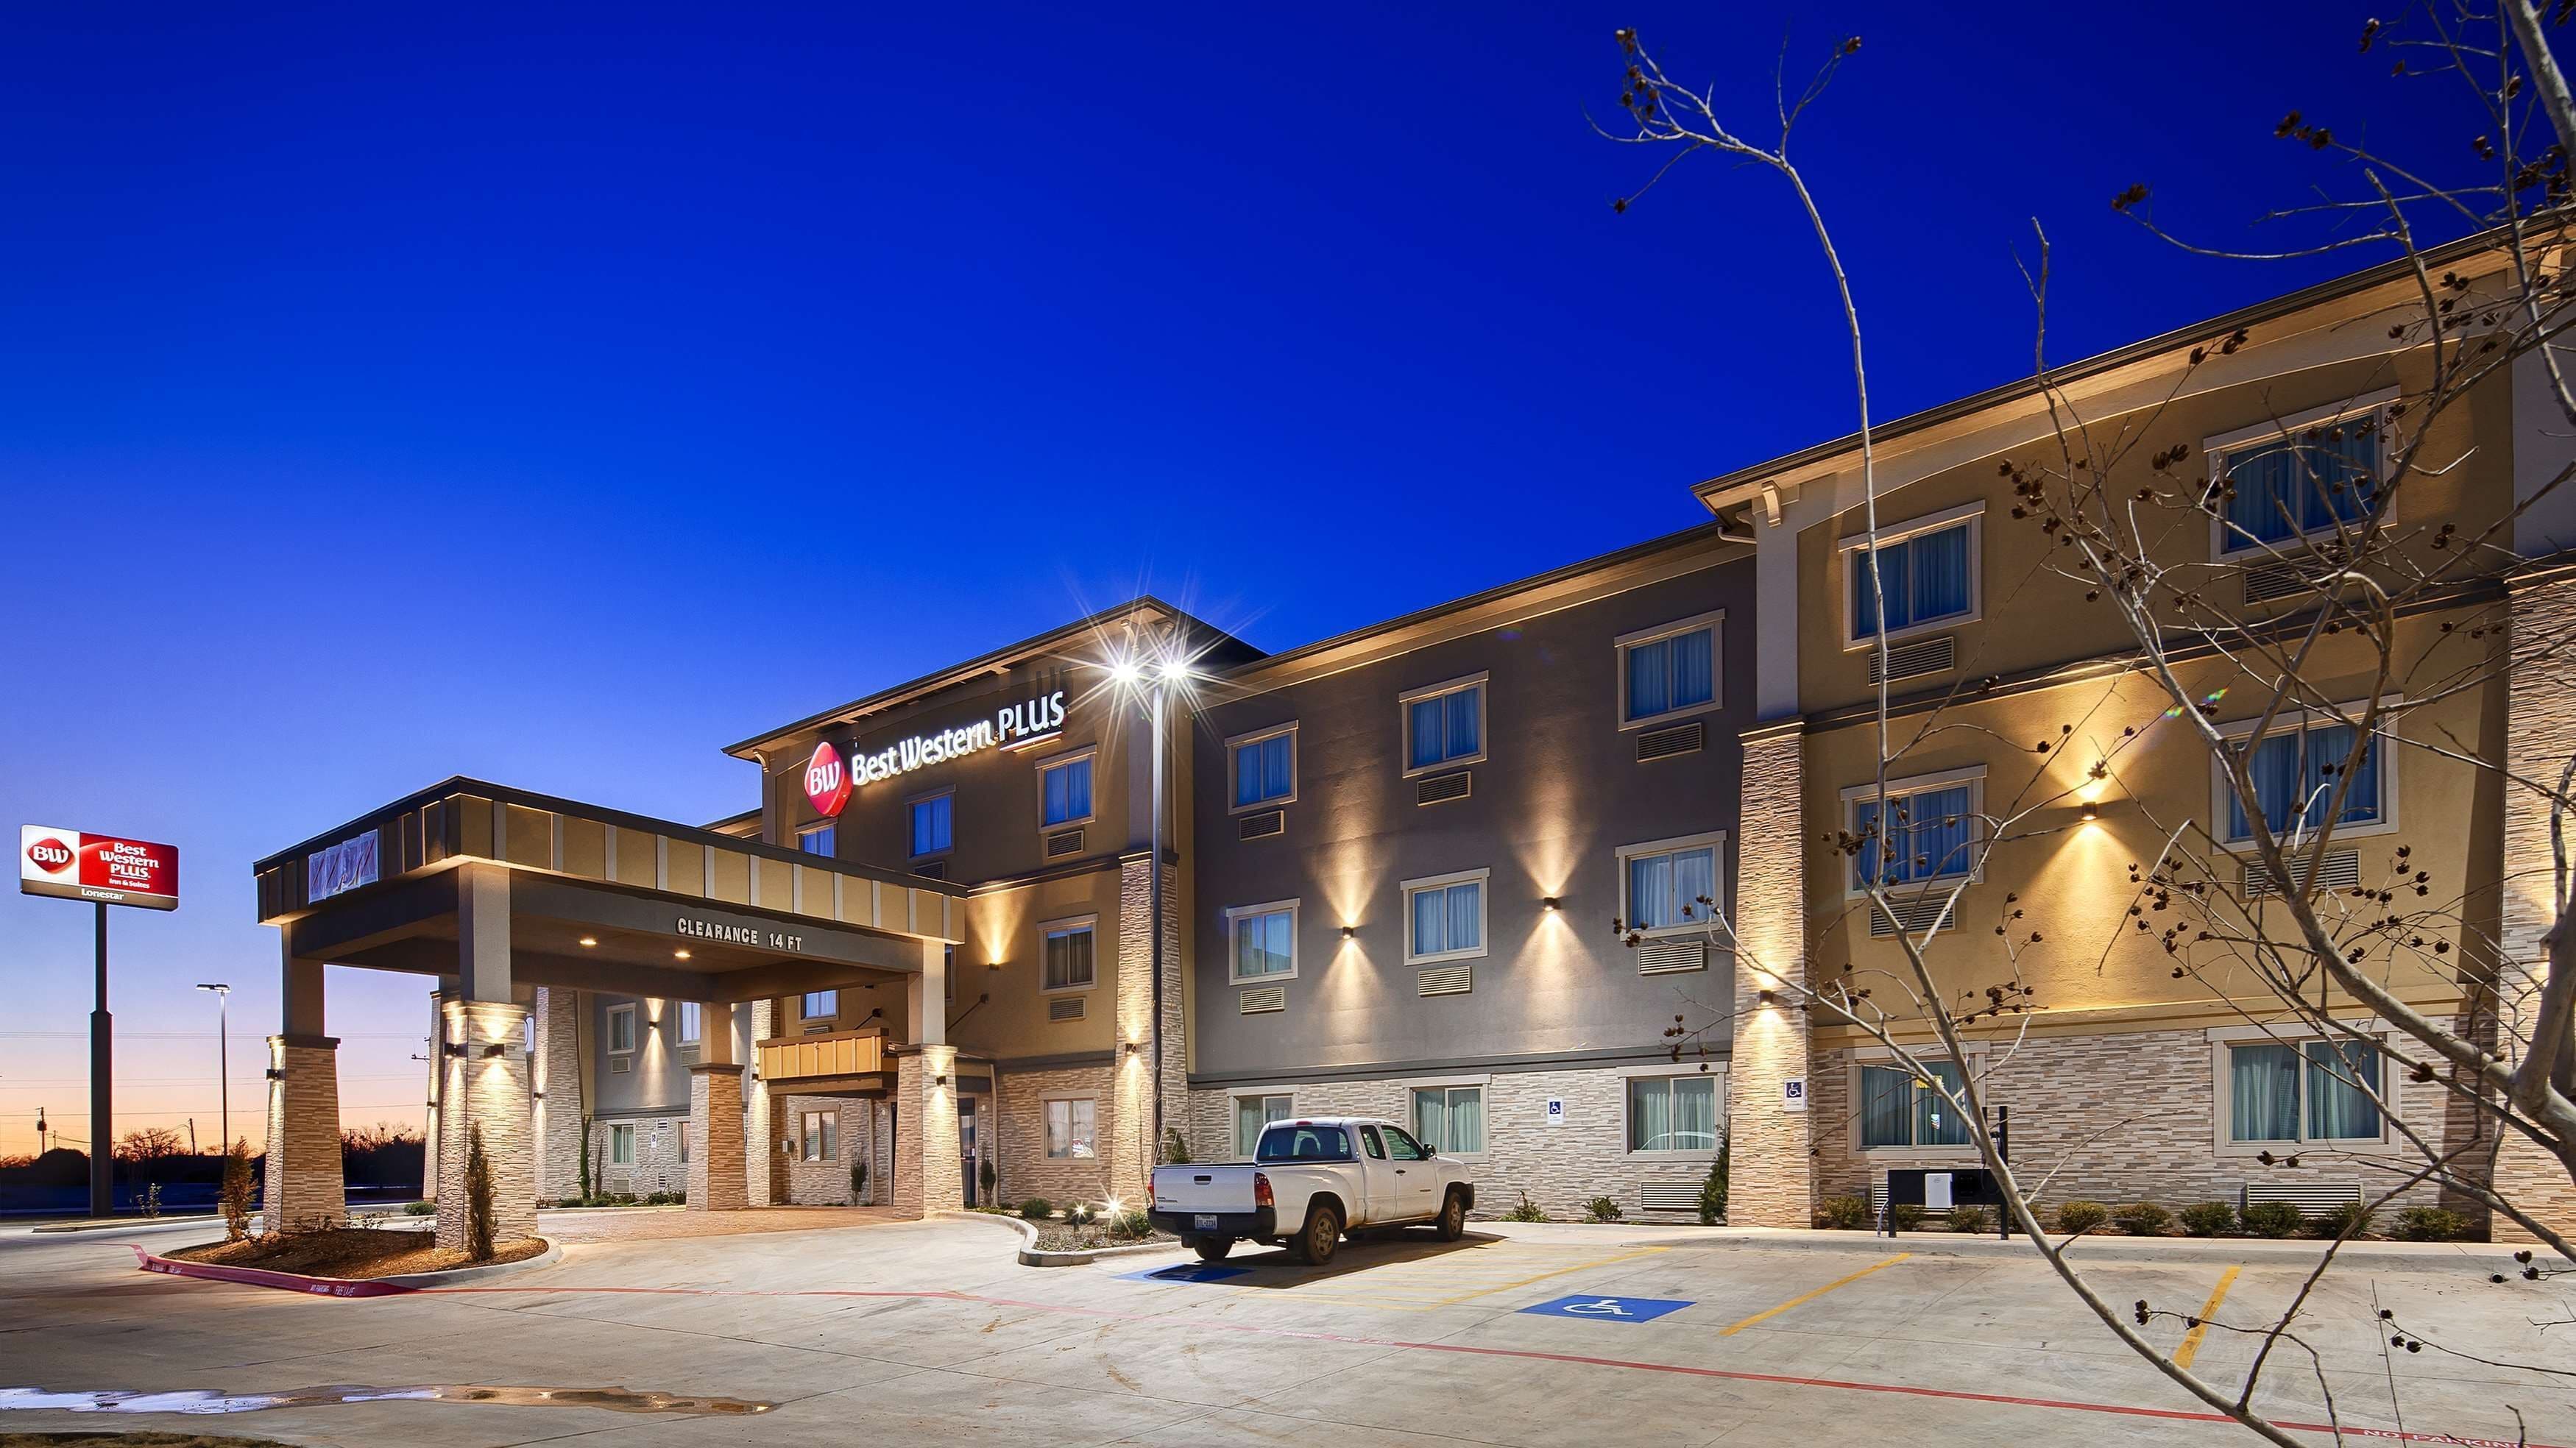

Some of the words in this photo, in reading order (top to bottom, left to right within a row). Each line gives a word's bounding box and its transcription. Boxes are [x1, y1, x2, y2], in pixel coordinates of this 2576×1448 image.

[852, 751, 902, 786] Best
[899, 720, 996, 772] Western
[998, 691, 1065, 742] PLUS
[809, 760, 841, 796] BW
[33, 845, 69, 864] BW
[114, 842, 146, 856] Best
[99, 850, 159, 868] Western
[81, 887, 124, 900] Lonestar
[677, 918, 758, 945] CLEARANCE
[769, 932, 784, 948] 14
[788, 935, 802, 951] FT
[2363, 1430, 2400, 1438] NO
